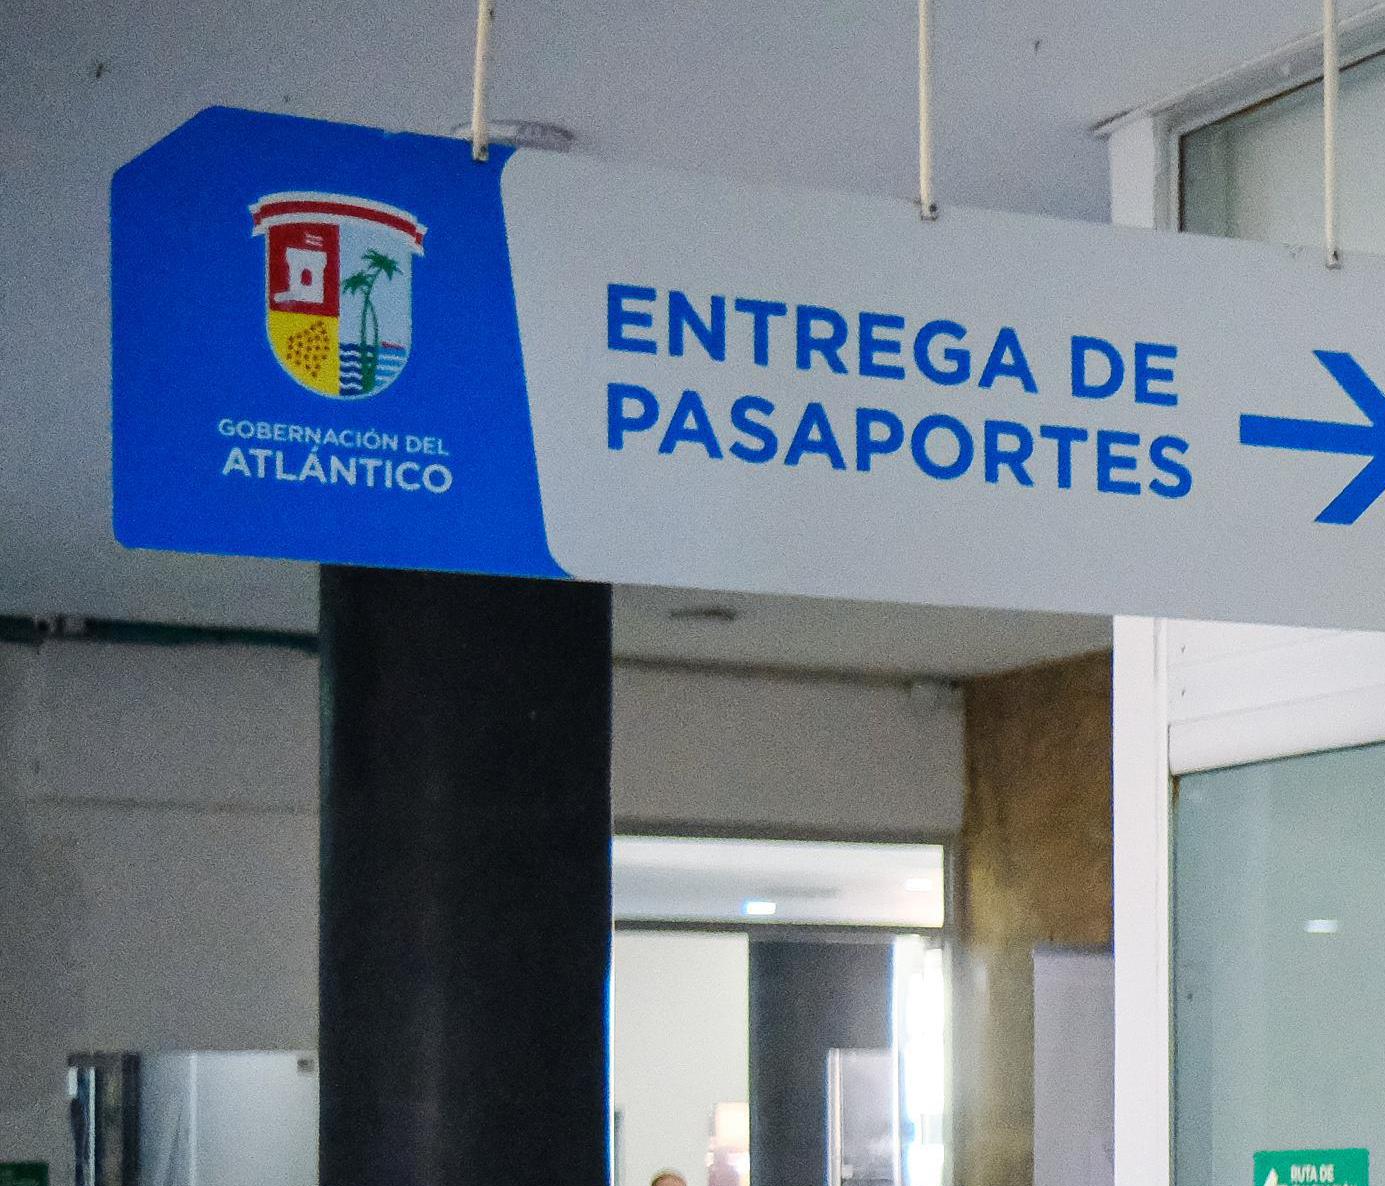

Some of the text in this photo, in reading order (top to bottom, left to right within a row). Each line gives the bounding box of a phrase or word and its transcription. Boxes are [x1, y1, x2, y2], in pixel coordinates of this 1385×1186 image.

[606, 283, 1180, 407] ENTREGA DE
[218, 418, 450, 456] GOBERNACIÓN DEL
[606, 382, 1193, 499] PASAPORTES
[221, 441, 453, 494] ATLÁNTICO
[1290, 1163, 1335, 1183] RUTA DE
